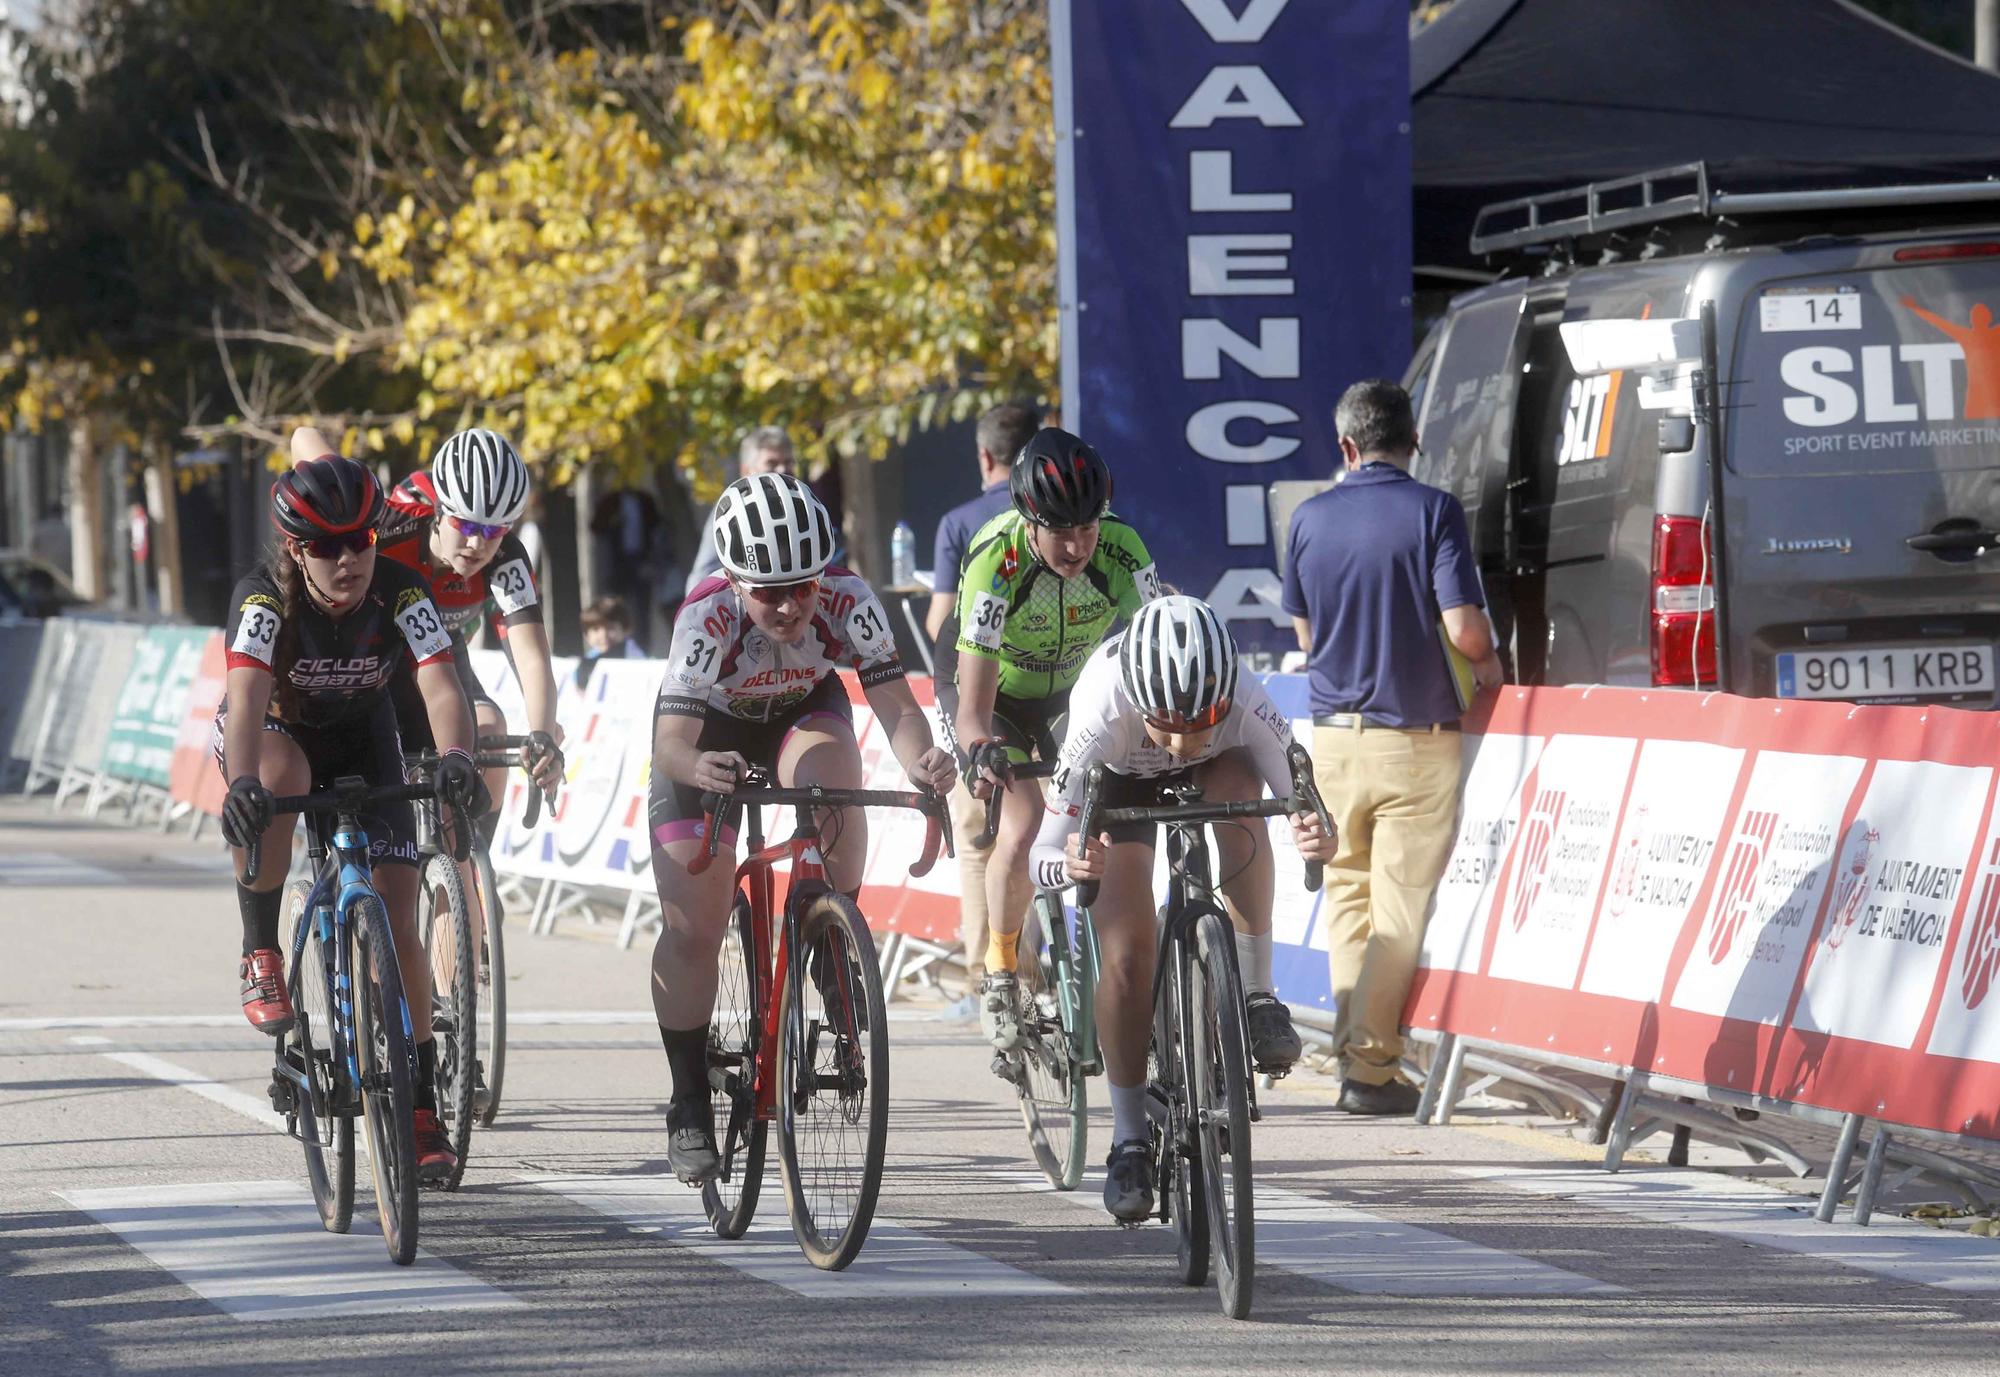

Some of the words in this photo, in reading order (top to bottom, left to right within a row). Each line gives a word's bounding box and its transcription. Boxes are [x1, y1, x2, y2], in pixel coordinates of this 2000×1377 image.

[1168, 0, 1304, 628] VALENCIA
[1805, 298, 1843, 324] 14
[1780, 342, 1966, 428] SLT
[1554, 374, 1612, 466] SLT
[1784, 435, 1844, 455] SPORT
[1848, 431, 1905, 450] EVENT
[1762, 537, 1851, 553] Jumpy
[498, 566, 525, 597] 23
[247, 612, 275, 645] 33
[406, 607, 438, 641] 33
[854, 605, 885, 641] 31
[978, 599, 1004, 631] 36
[294, 656, 379, 674] CICLOS
[686, 638, 717, 674] 31
[1805, 654, 1894, 692] 9011
[1913, 650, 1984, 687] KRB
[1776, 823, 1832, 854] Fundación
[1764, 859, 1818, 896] Deportiva
[1874, 859, 1962, 901] AJUNTAMENT
[1752, 897, 1807, 940] Municipal
[1858, 904, 1883, 937] DE
[1882, 900, 1946, 948] VALÈNCIA
